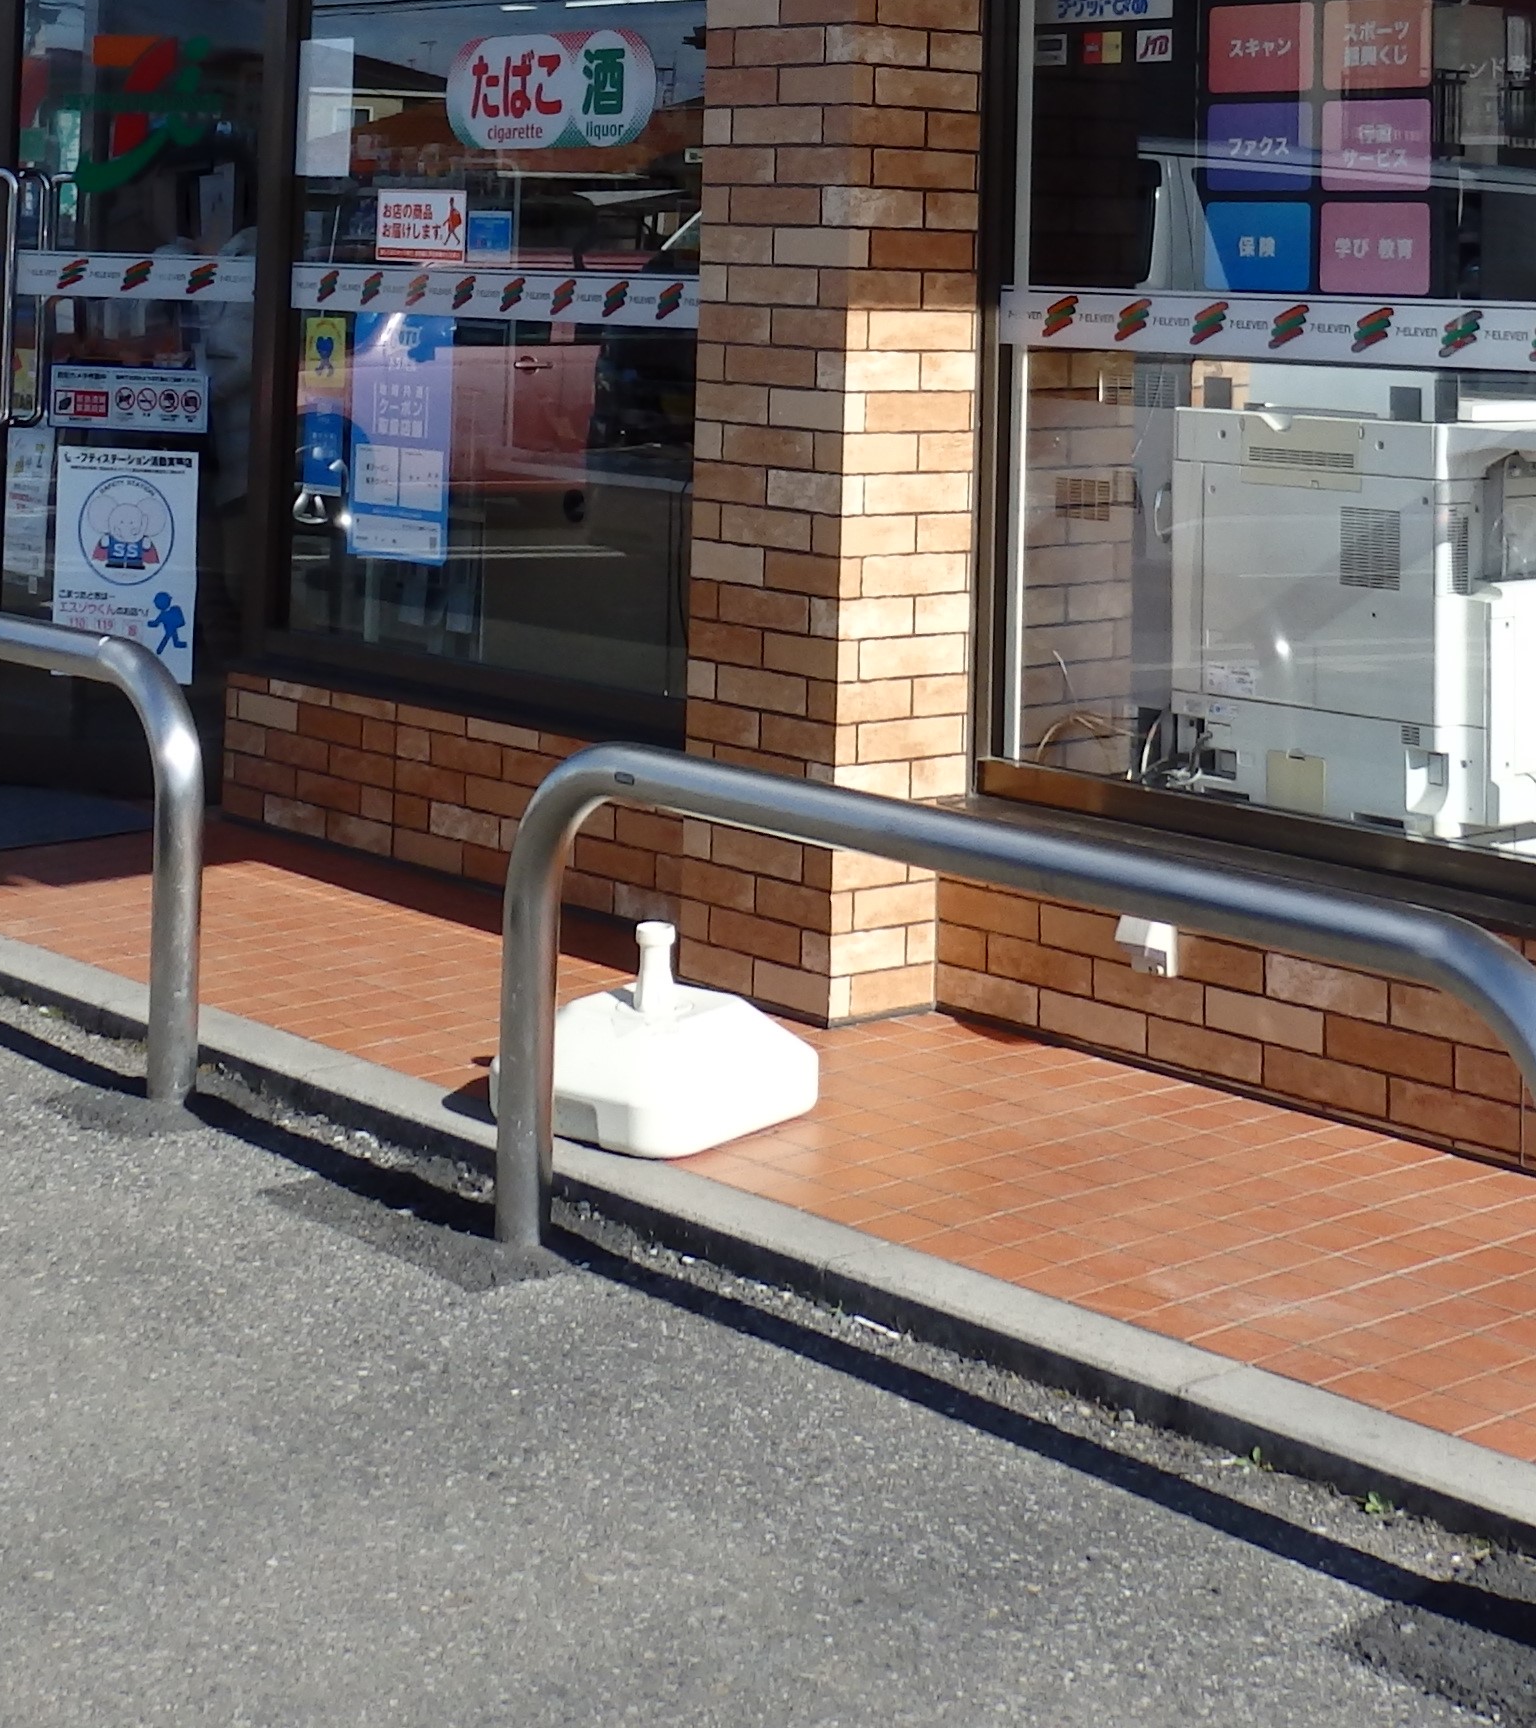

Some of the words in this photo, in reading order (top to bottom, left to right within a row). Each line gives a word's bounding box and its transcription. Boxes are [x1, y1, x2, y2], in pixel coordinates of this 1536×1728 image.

[1344, 21, 1410, 43] スポーツ
[1139, 35, 1170, 60] JTB
[1229, 37, 1292, 58] スキャン
[471, 49, 563, 119] たばこ
[582, 48, 626, 116] 酒
[487, 123, 544, 144] cigarette
[585, 122, 624, 141] liquor
[1228, 136, 1290, 157] ファクス
[1342, 148, 1408, 169] サービス
[383, 203, 433, 220] お店の商品
[1238, 235, 1276, 257] 保険
[1334, 237, 1370, 259] 学び
[1377, 238, 1414, 260] 教育
[379, 398, 423, 416] クーポン
[112, 543, 139, 558] SS
